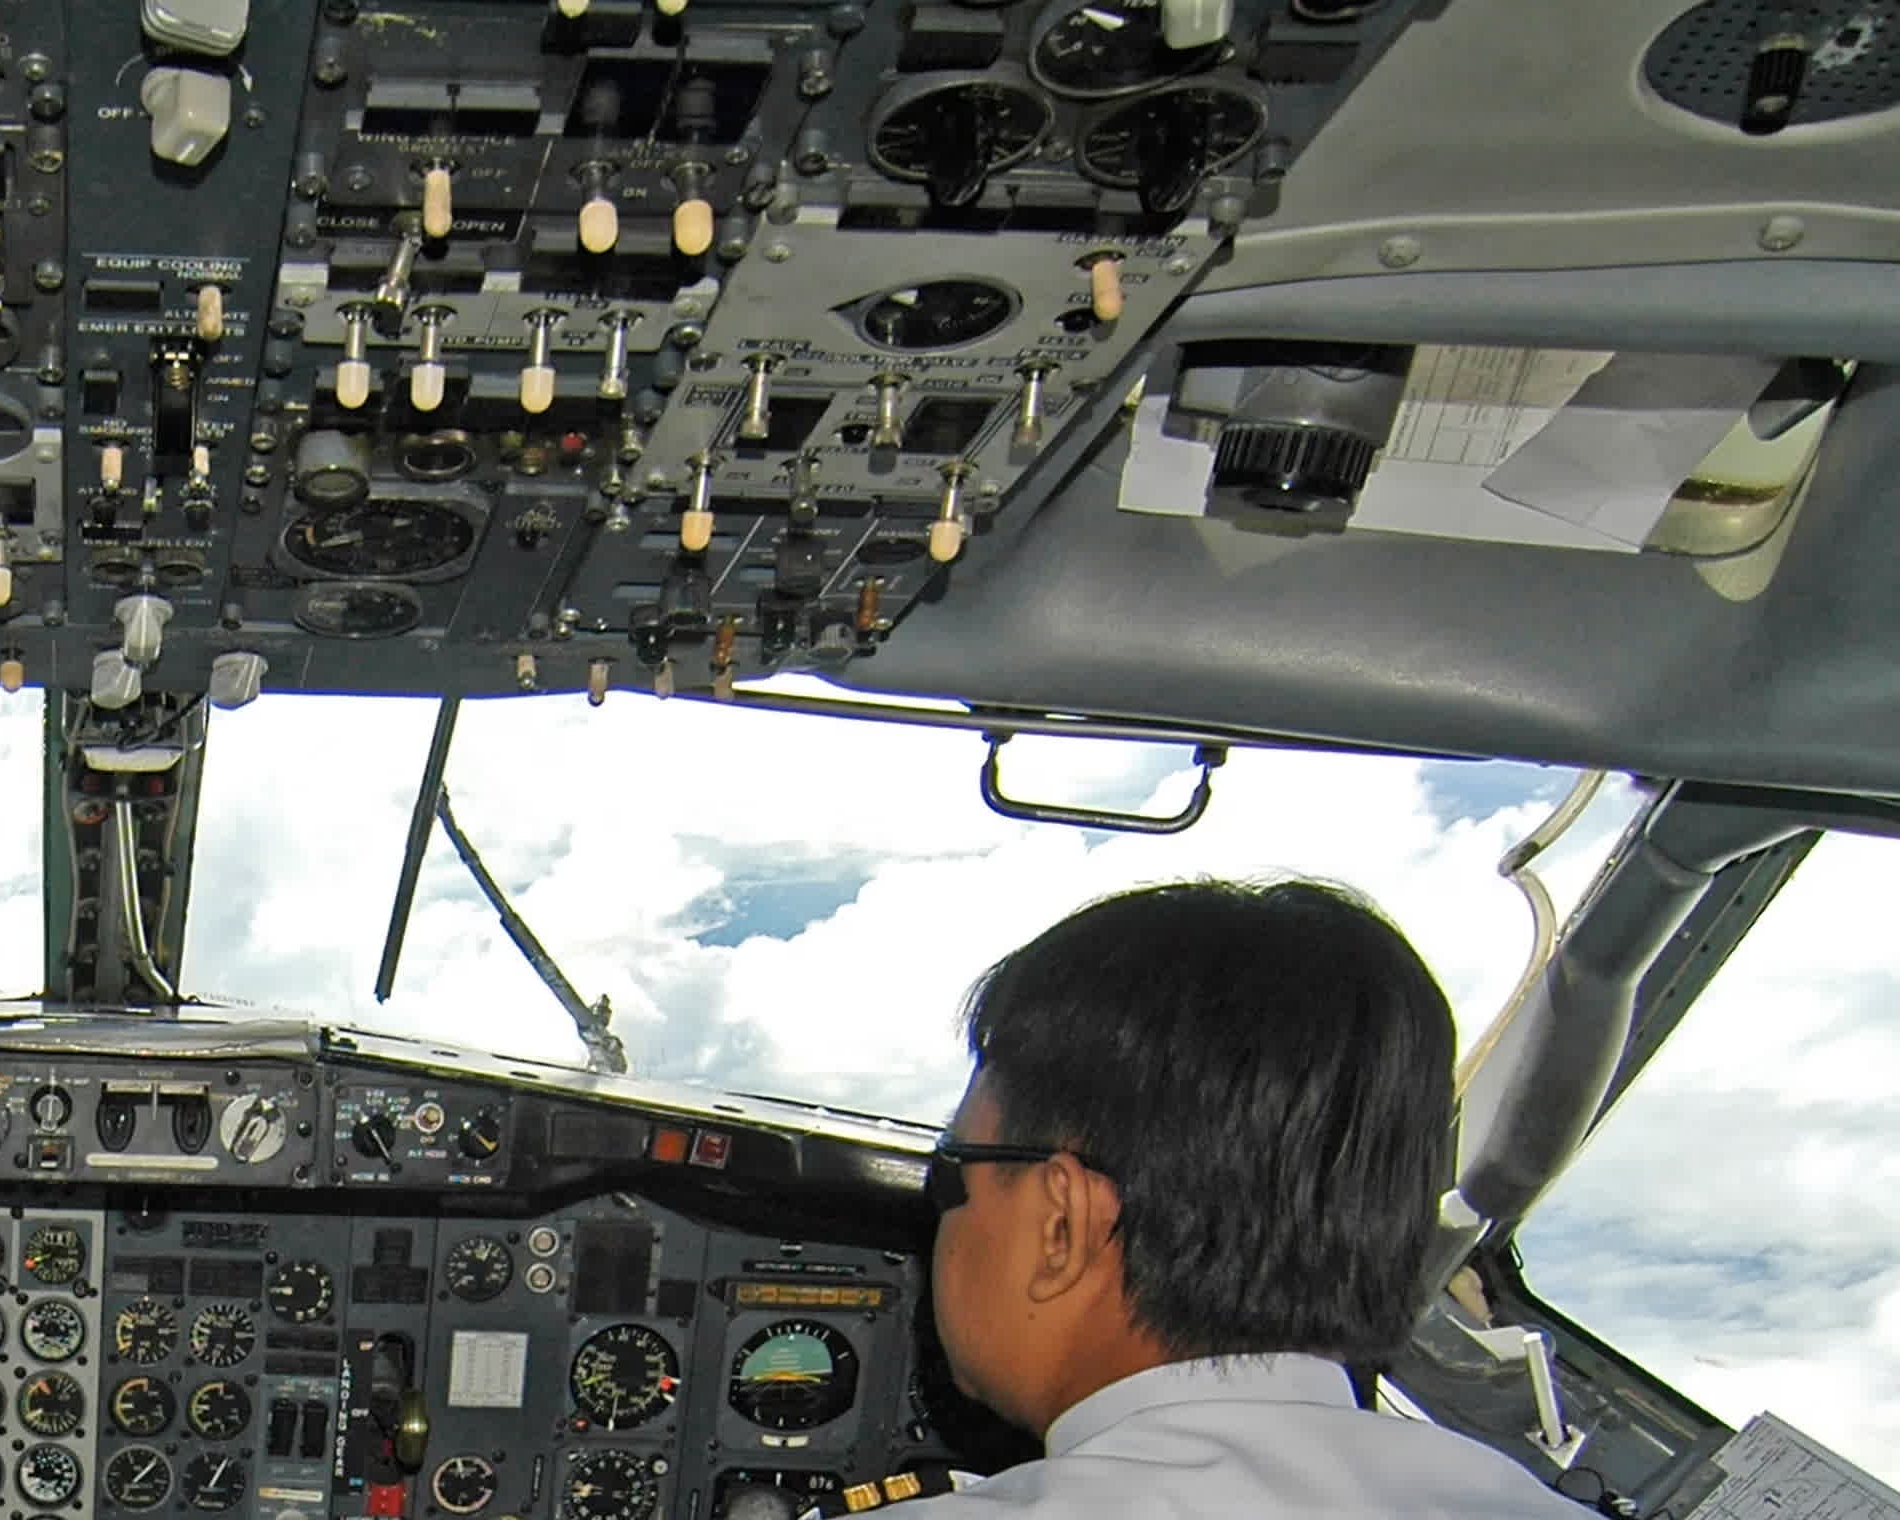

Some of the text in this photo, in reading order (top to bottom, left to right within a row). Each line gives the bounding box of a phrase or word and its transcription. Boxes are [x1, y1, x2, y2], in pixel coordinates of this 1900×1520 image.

[98, 108, 134, 119] OFF
[316, 215, 506, 232] CLOSE OPEN
[95, 257, 242, 273] EQUIP COOLING
